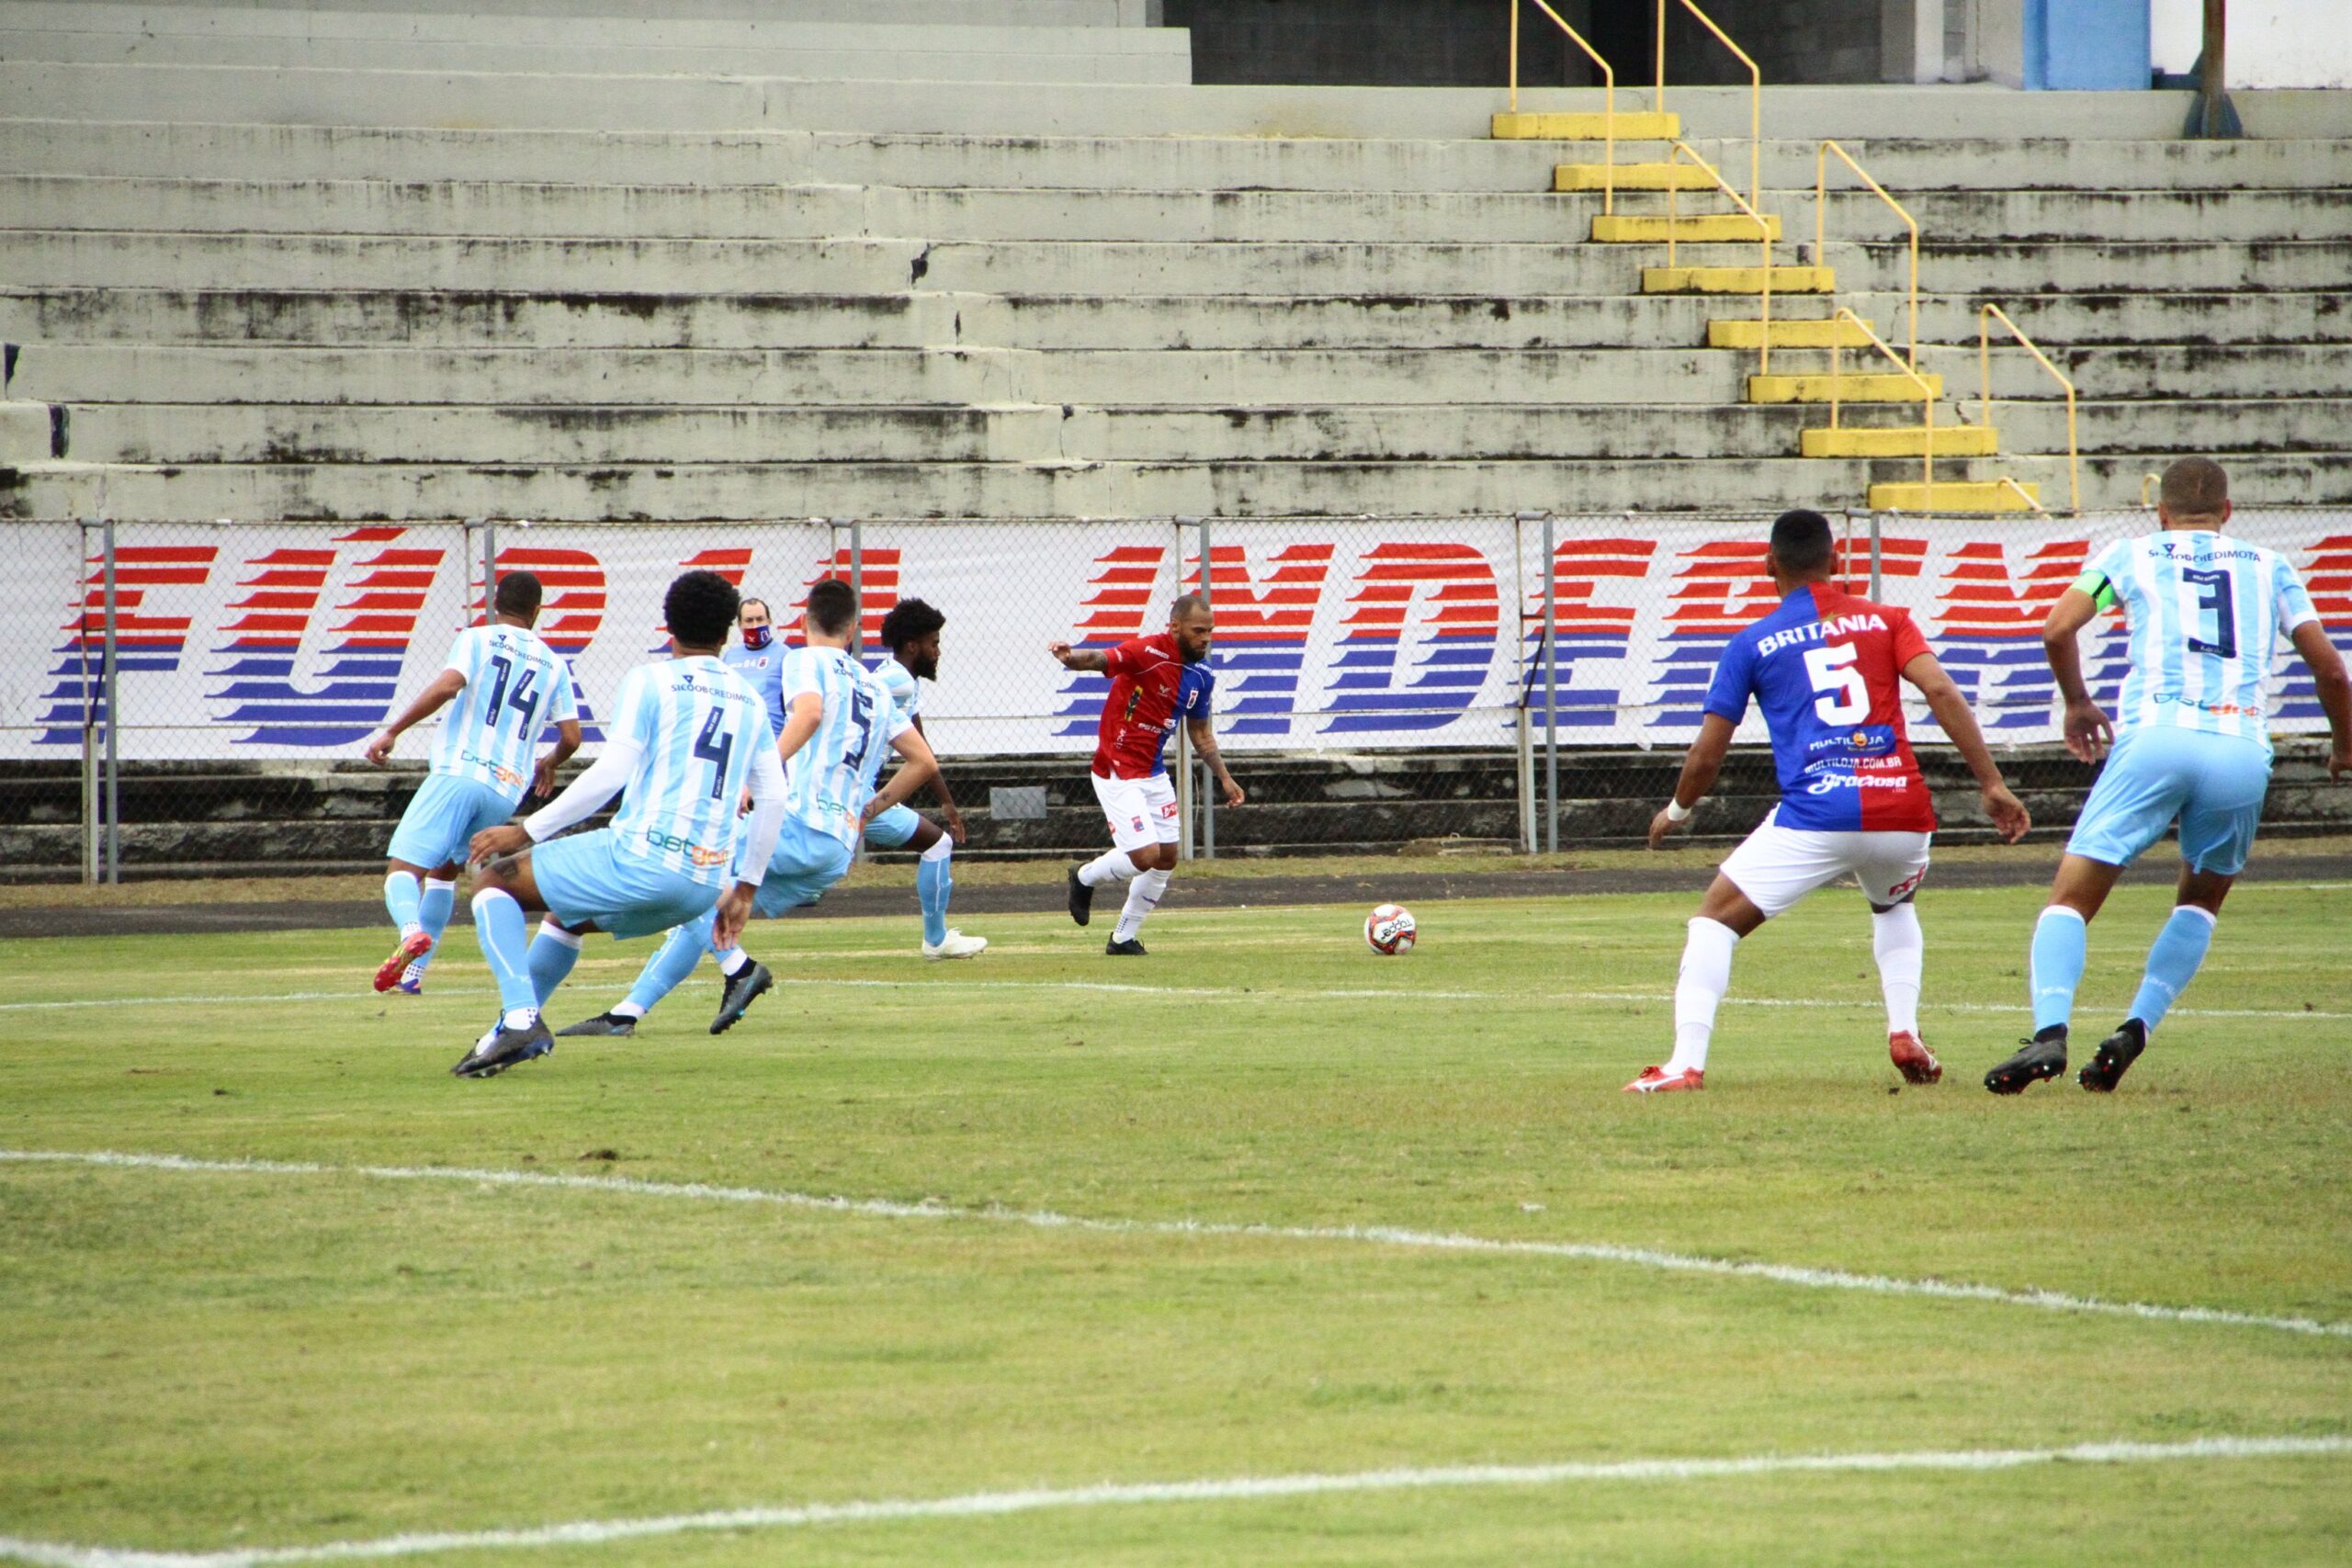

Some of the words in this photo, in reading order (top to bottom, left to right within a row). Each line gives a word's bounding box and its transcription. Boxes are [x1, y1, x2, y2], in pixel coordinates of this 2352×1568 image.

[1757, 614, 1888, 658] BRITANIA
[2183, 567, 2236, 659] 3
[485, 654, 539, 741] 14
[671, 683, 708, 694] SICOOB
[1803, 642, 1871, 727] 5
[694, 705, 733, 800] 4
[842, 687, 874, 773] 5
[1804, 756, 1903, 774] MULTILOJA.COM.BR
